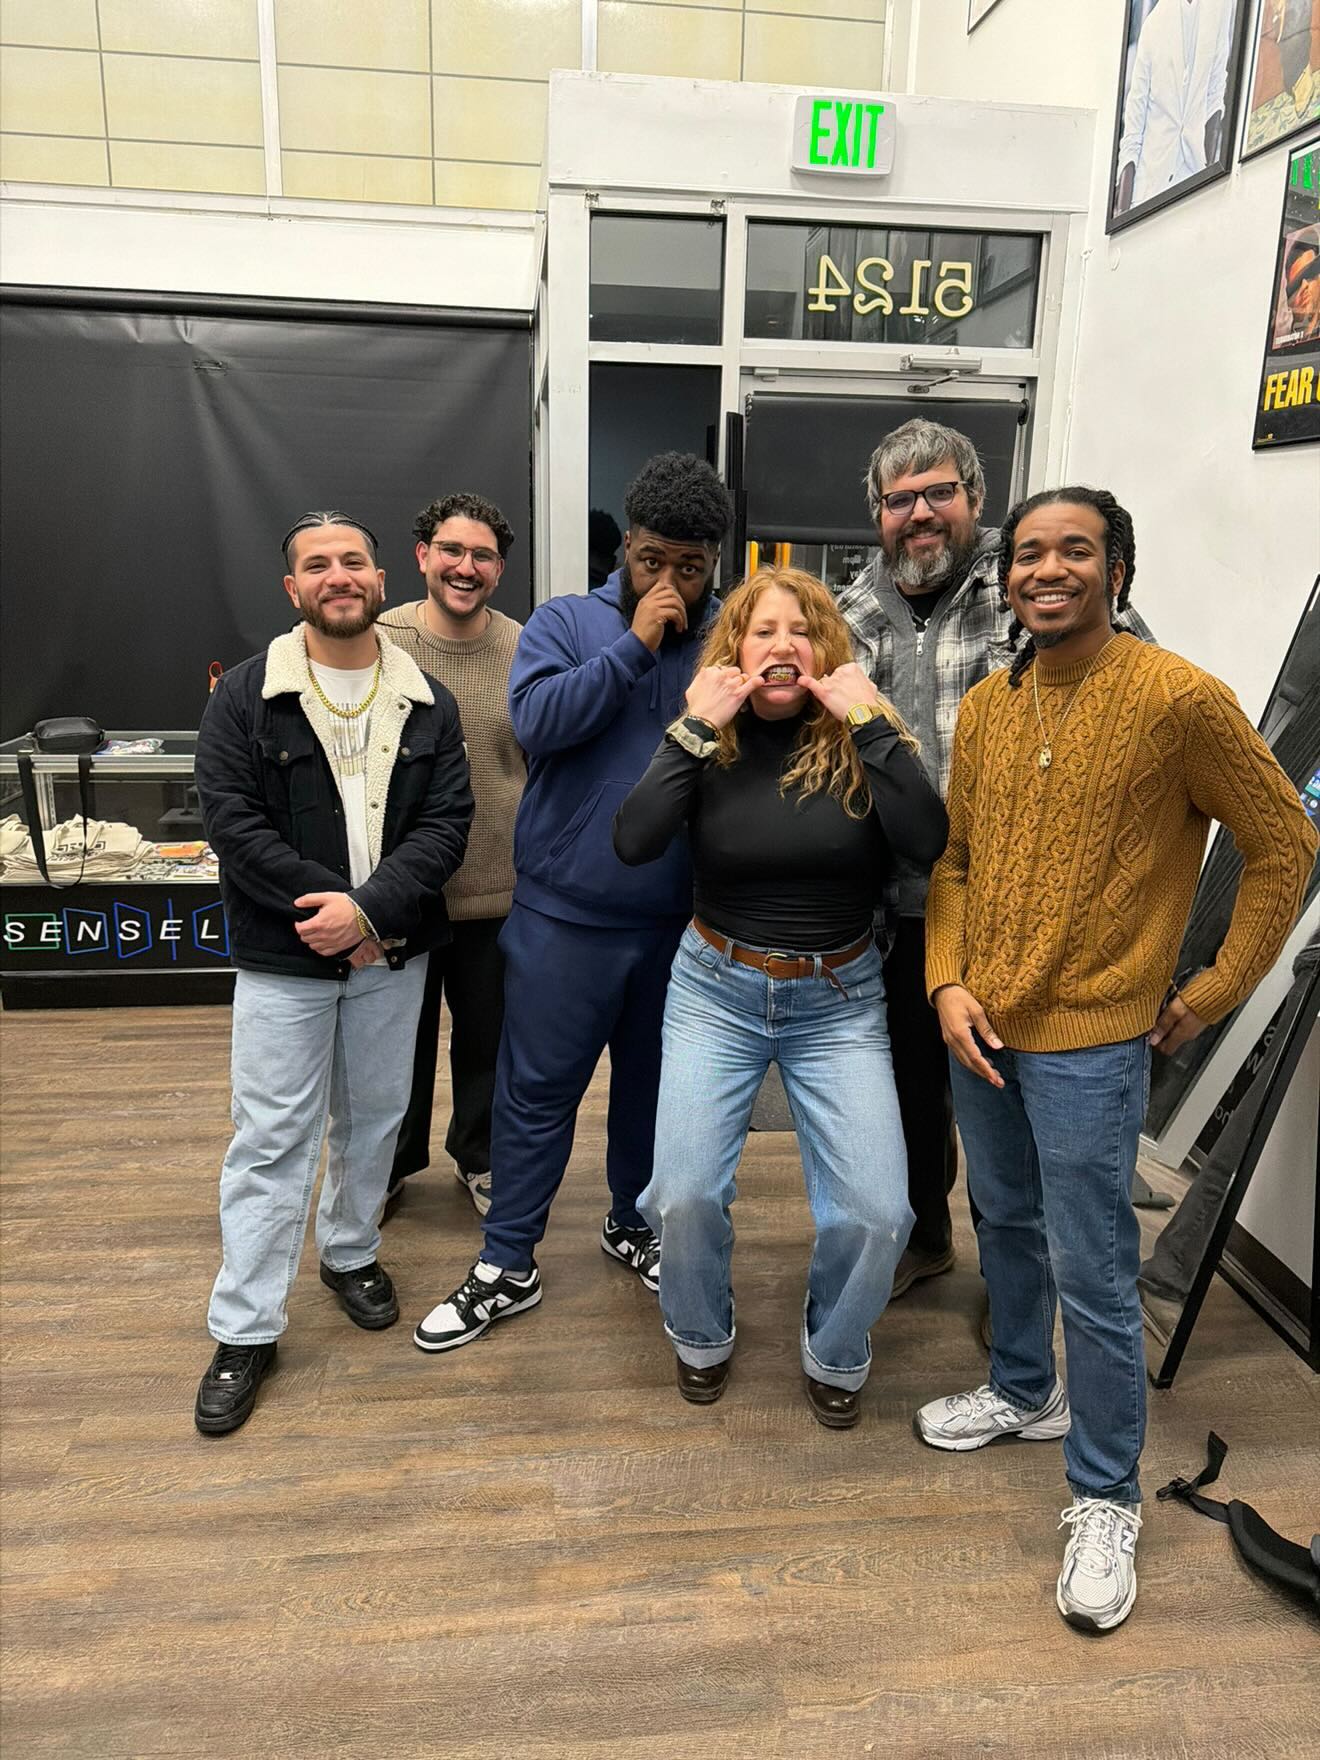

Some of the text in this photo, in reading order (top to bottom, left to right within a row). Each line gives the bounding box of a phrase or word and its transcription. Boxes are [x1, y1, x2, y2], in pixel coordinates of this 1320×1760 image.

[809, 99, 885, 168] EXIT
[1263, 366, 1314, 411] FEAR
[3, 918, 220, 943] SENSEL
[993, 1410, 1020, 1428] N
